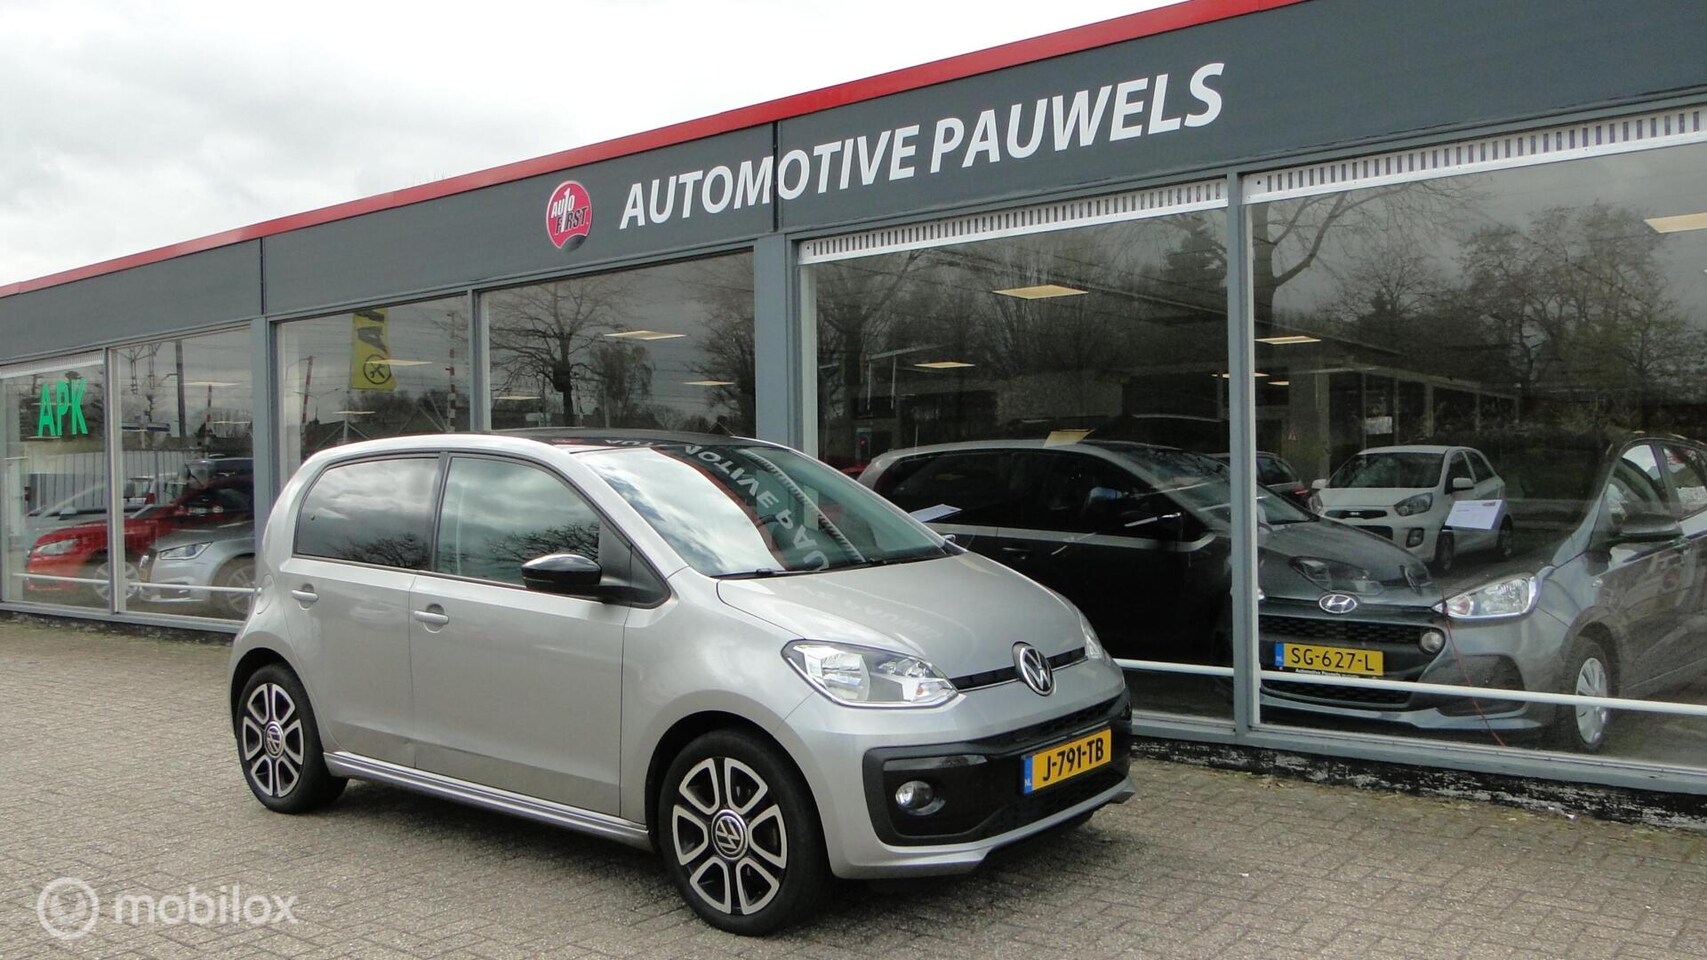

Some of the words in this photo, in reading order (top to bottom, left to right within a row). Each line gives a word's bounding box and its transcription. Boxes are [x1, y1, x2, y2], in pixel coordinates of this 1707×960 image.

[619, 124, 920, 230] AUTOMOTIVE
[930, 62, 1225, 173] PAUWELS
[551, 188, 575, 220] AUTO
[38, 377, 88, 438] APK
[1292, 647, 1375, 672] SG-627-L
[1043, 737, 1104, 782] J-791-TB
